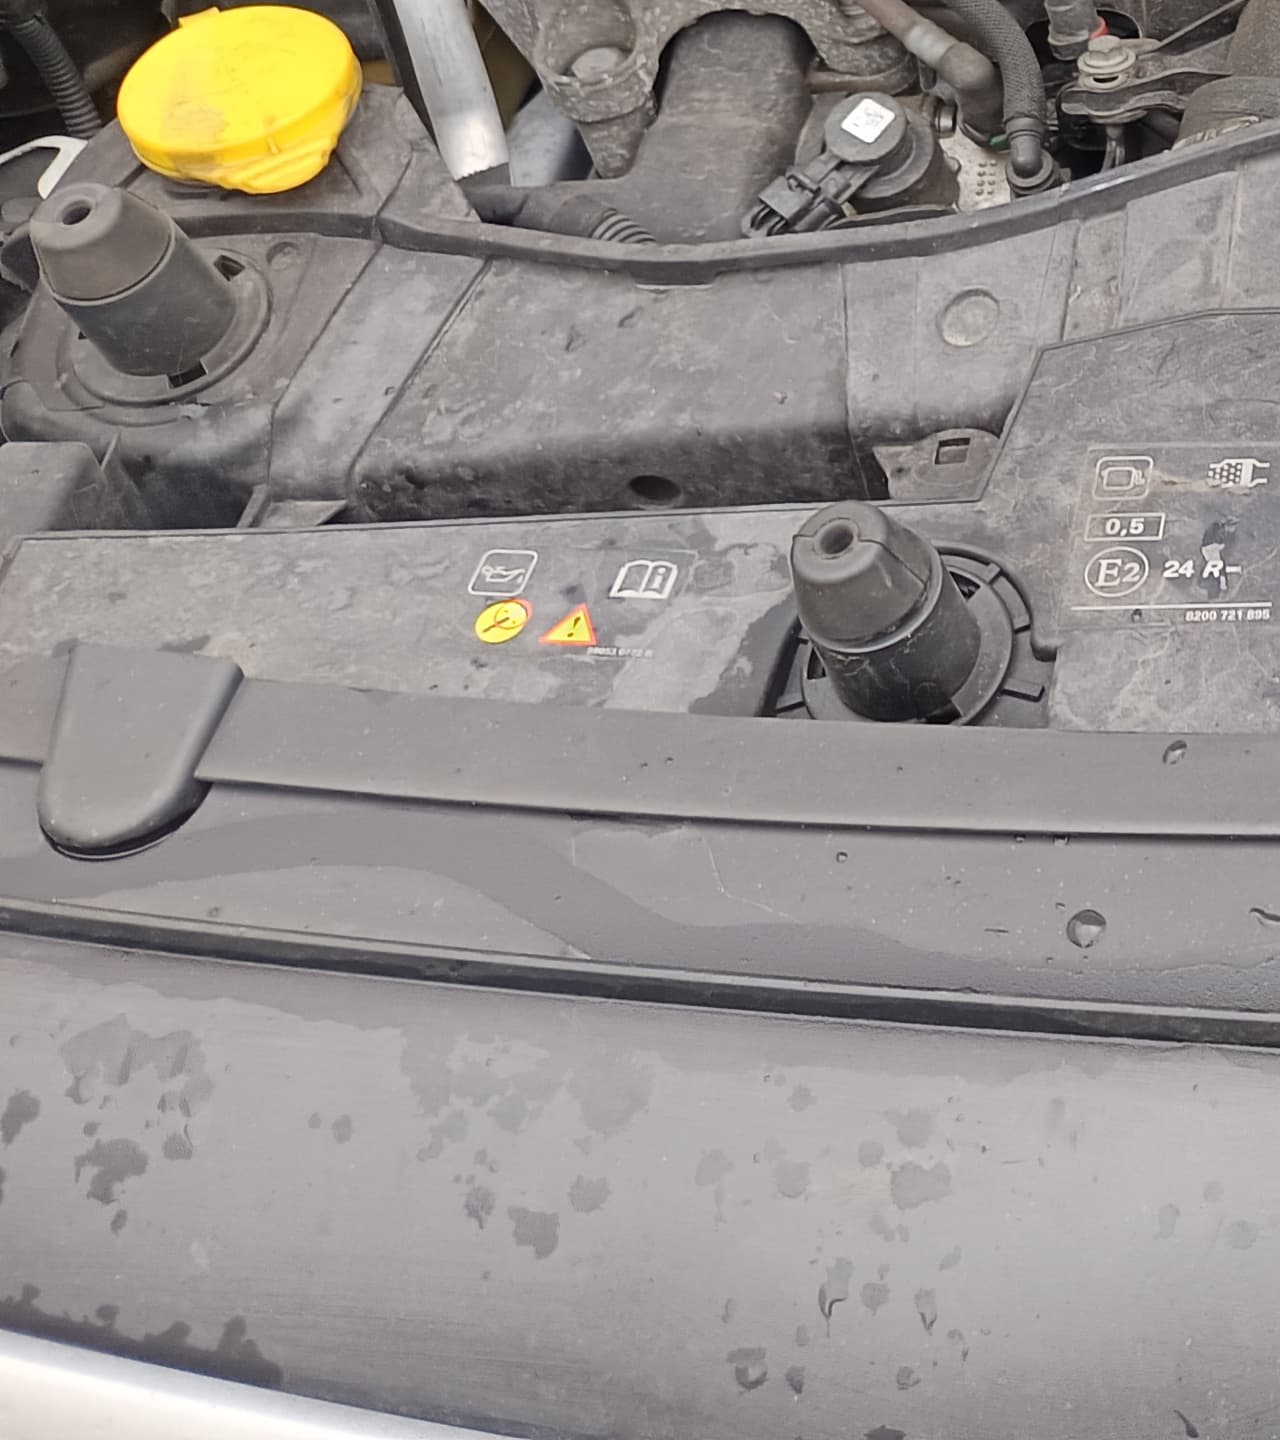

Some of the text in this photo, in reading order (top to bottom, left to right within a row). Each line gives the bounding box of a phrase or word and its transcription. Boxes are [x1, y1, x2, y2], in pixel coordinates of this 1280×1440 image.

[1105, 518, 1145, 537] 0,5
[1094, 558, 1141, 588] E2
[1163, 560, 1195, 578] 24
